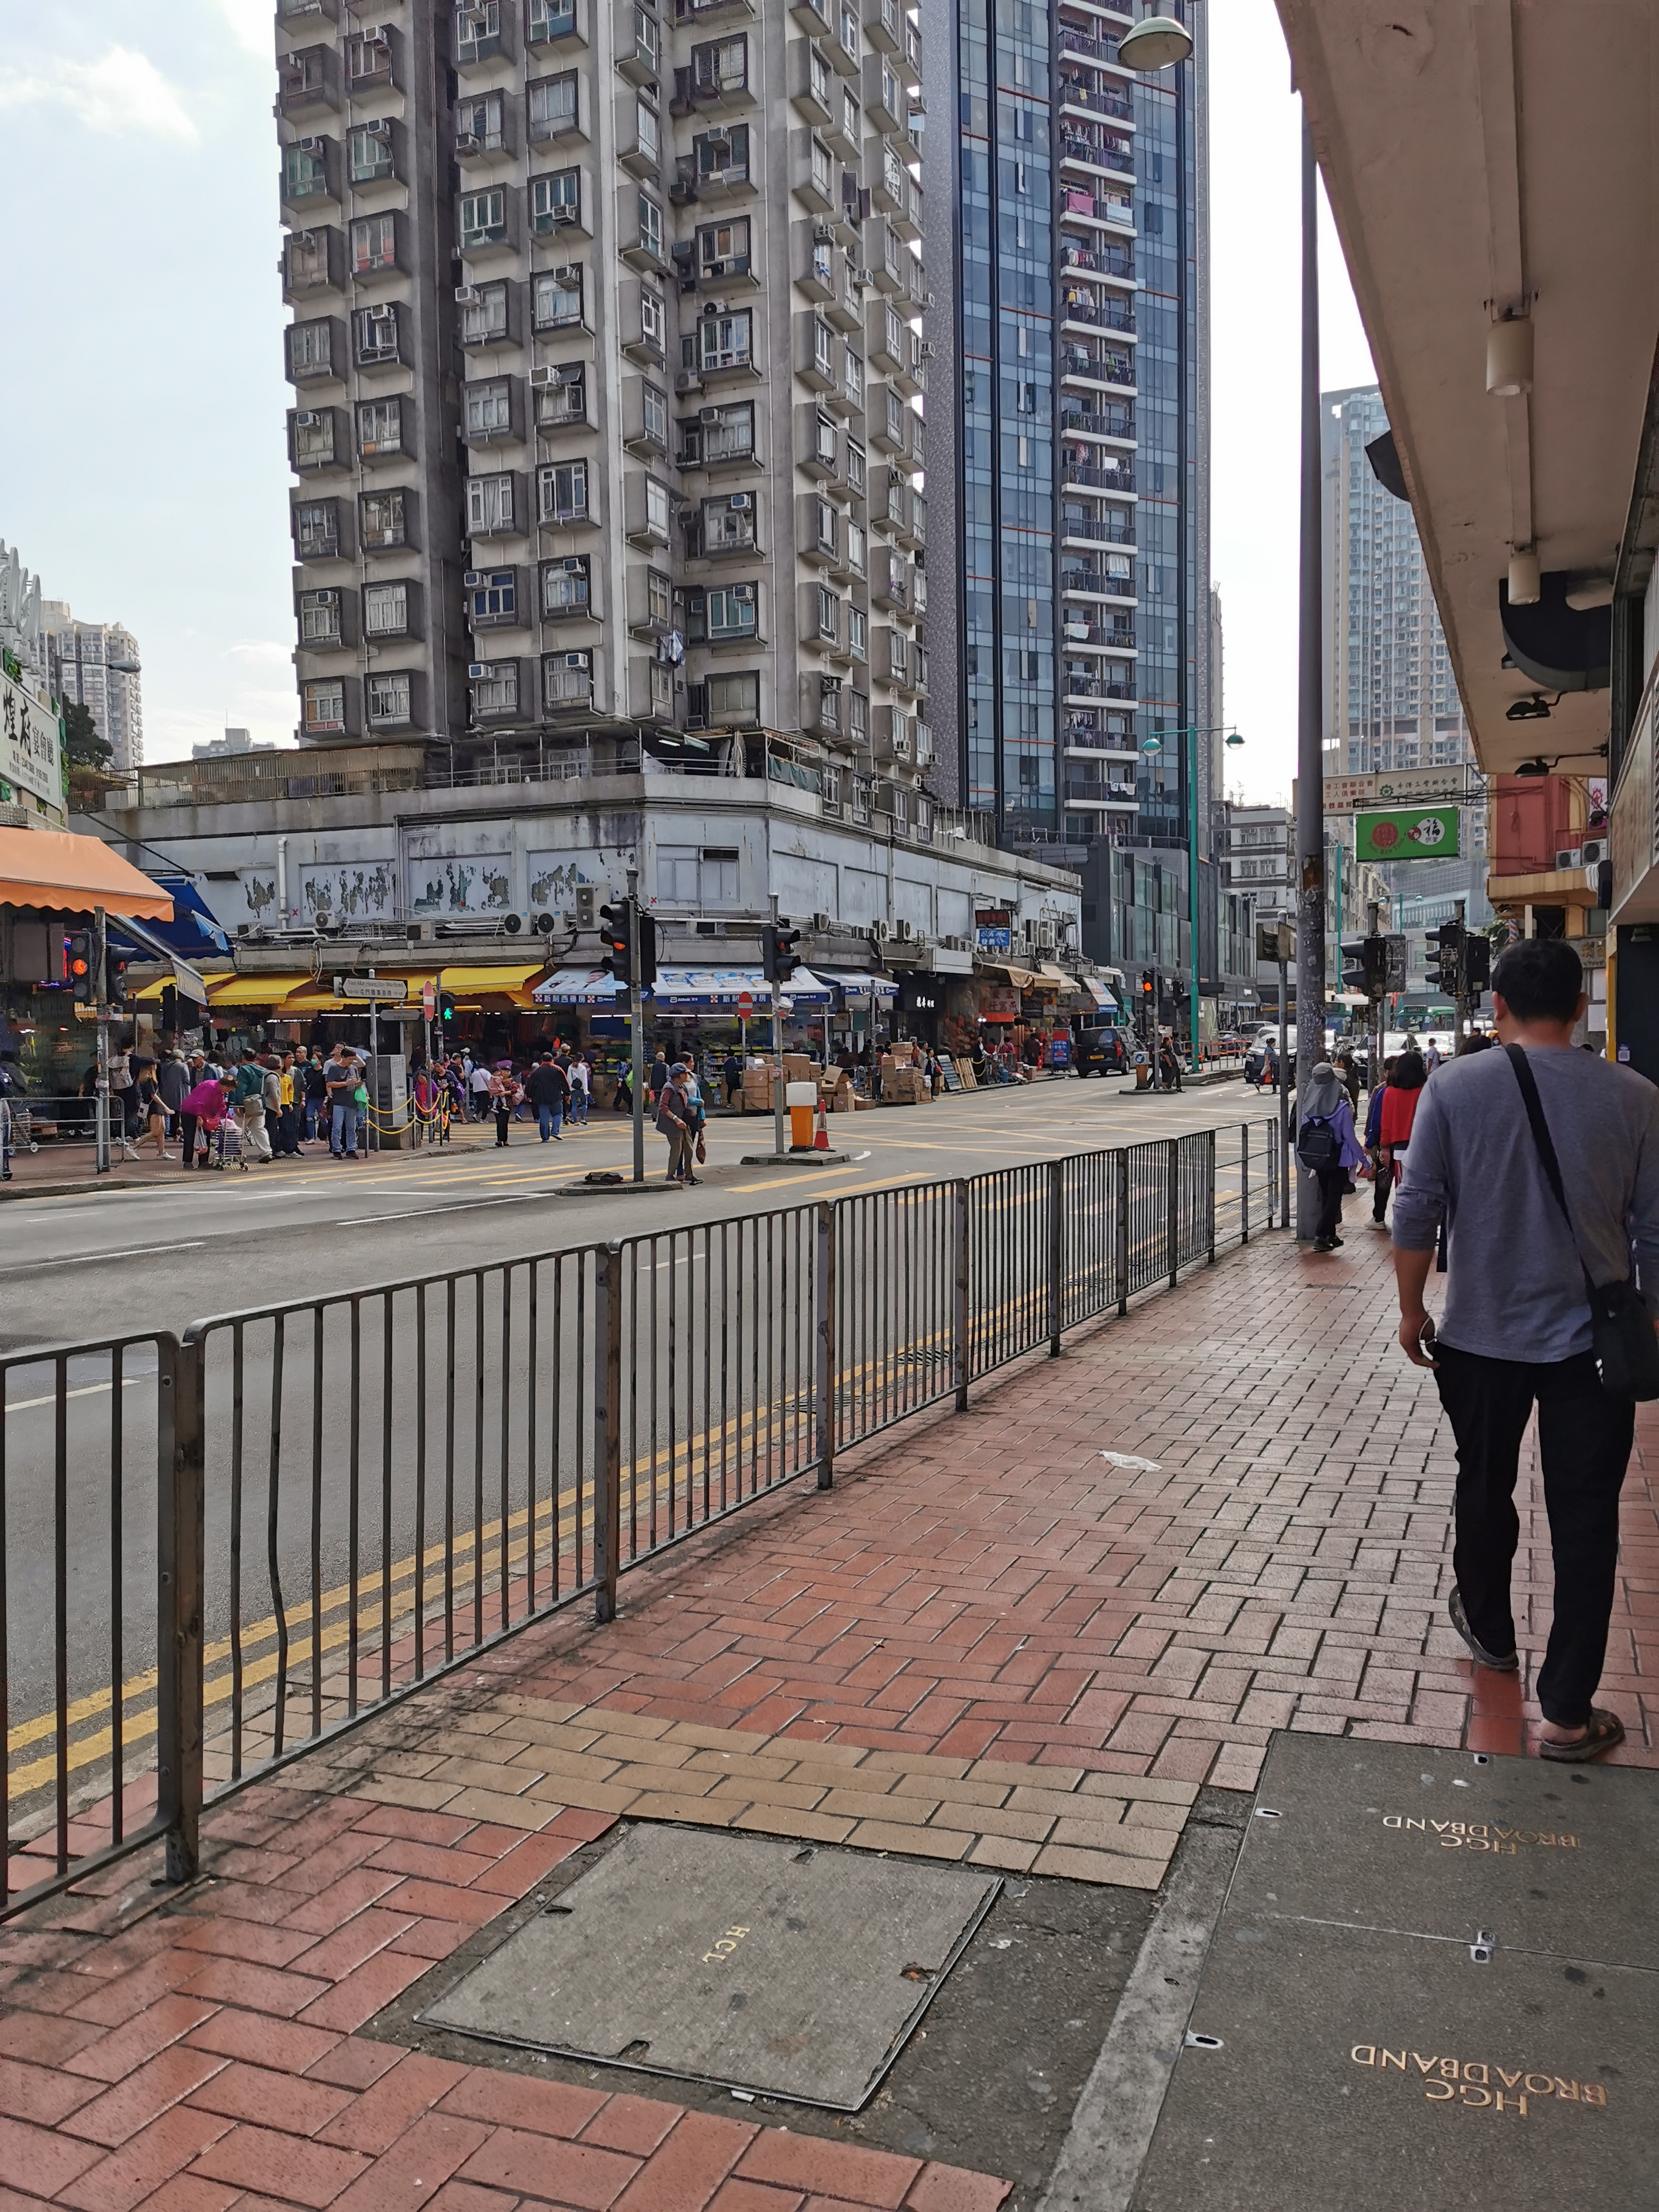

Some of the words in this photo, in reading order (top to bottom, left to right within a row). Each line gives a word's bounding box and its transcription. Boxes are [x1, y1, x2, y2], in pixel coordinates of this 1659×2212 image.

[1423, 819, 1441, 837] 福
[1382, 1815, 1579, 1848] BROADBAND
[1440, 1834, 1517, 1854] HGC
[702, 1926, 751, 1963] HCL
[1350, 2045, 1607, 2106] BROADBAND
[1425, 2079, 1528, 2116] HGC
